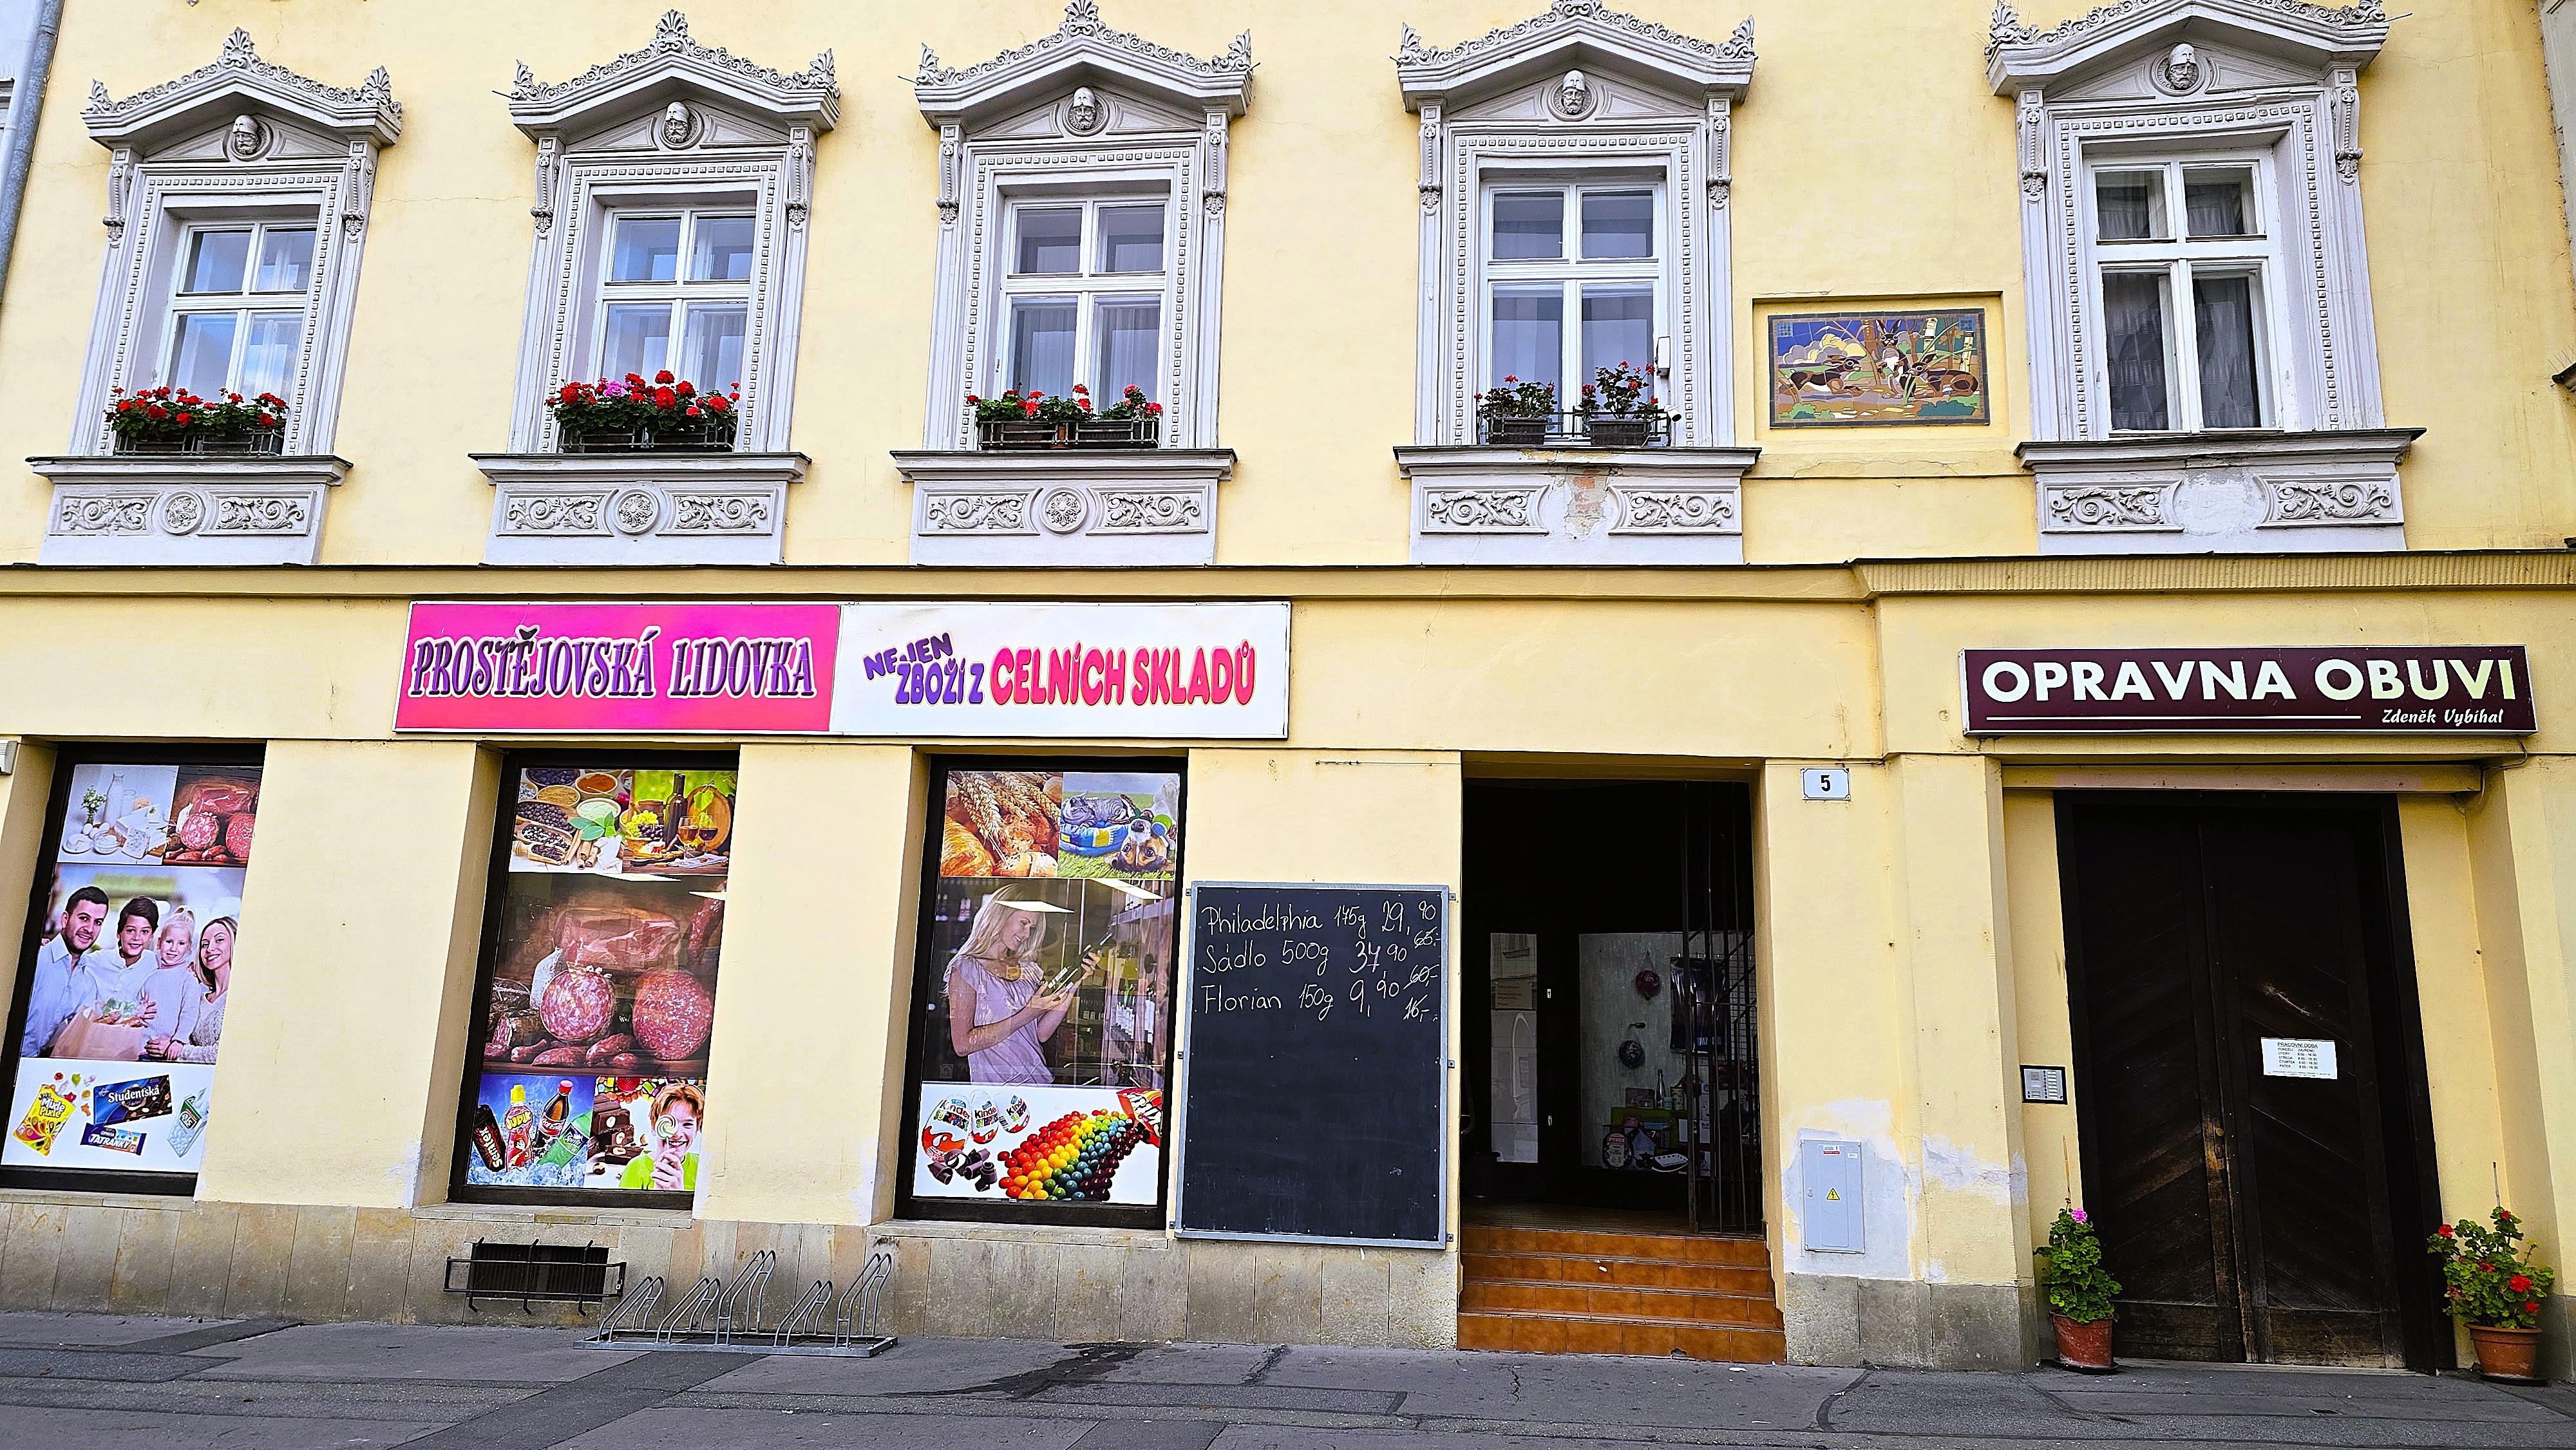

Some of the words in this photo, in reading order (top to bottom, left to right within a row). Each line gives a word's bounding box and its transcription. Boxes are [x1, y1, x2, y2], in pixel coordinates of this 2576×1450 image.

[410, 626, 659, 697] PROSTĚJOVSKÁ
[669, 638, 815, 697] LIDOVKA
[895, 657, 965, 704] ZBOŽÍ
[969, 663, 985, 704] Z
[989, 641, 1125, 705] CELNÍCH
[1132, 640, 1256, 706] SKLADŮ
[1982, 660, 2297, 703] OPRAVNA
[2314, 658, 2517, 701] OBUVI
[2382, 708, 2437, 724] Zdeněk
[1820, 775, 1831, 792] 5
[1201, 903, 1323, 936] Philadelphia
[1202, 939, 1266, 974] Sádlo
[1282, 939, 1329, 976] 500g
[1200, 984, 1282, 1014] Florian
[1298, 983, 1334, 1021] 150g
[108, 1084, 160, 1103] Studentská
[90, 1133, 132, 1149] TATRANKY
